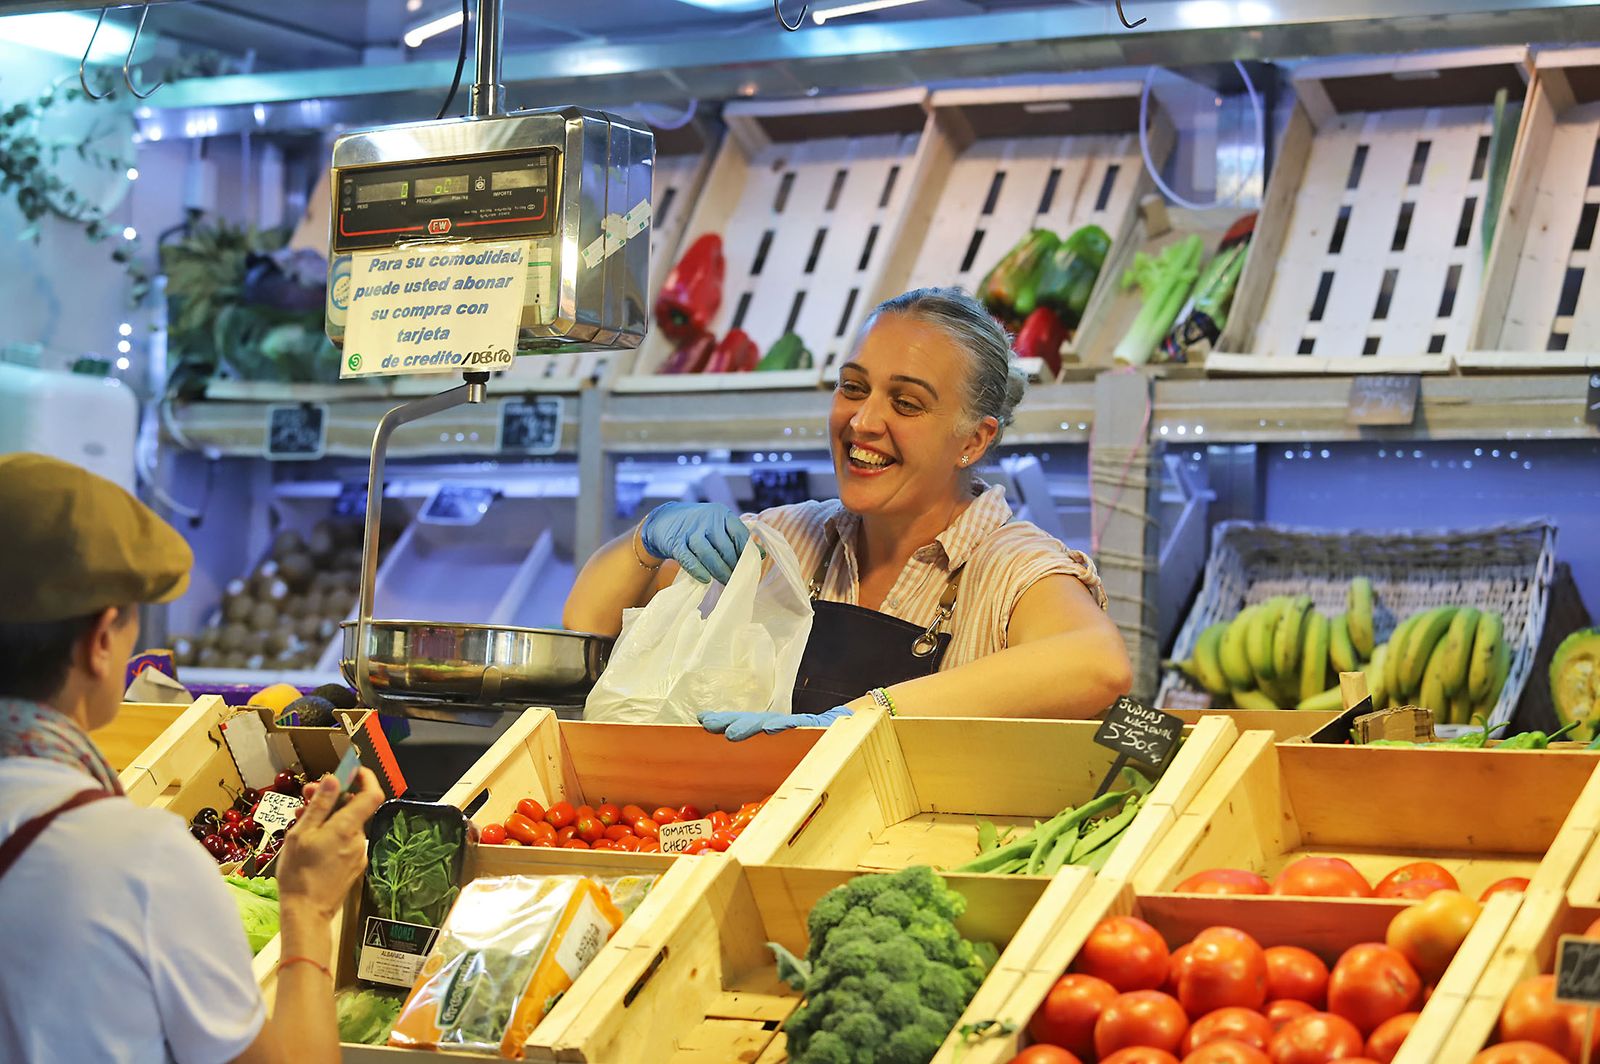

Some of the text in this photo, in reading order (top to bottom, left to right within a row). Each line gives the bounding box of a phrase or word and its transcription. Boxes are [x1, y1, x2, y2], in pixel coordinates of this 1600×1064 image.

[368, 249, 523, 273] Para su comodidad,
[353, 281, 400, 301] puede
[404, 277, 451, 293] usted
[452, 275, 514, 290] abonar
[370, 302, 489, 321] su compra con
[397, 327, 451, 345] tarjeta
[381, 354, 400, 369] de
[1119, 697, 1165, 724] JUDIAS
[661, 823, 702, 837] TOMATES
